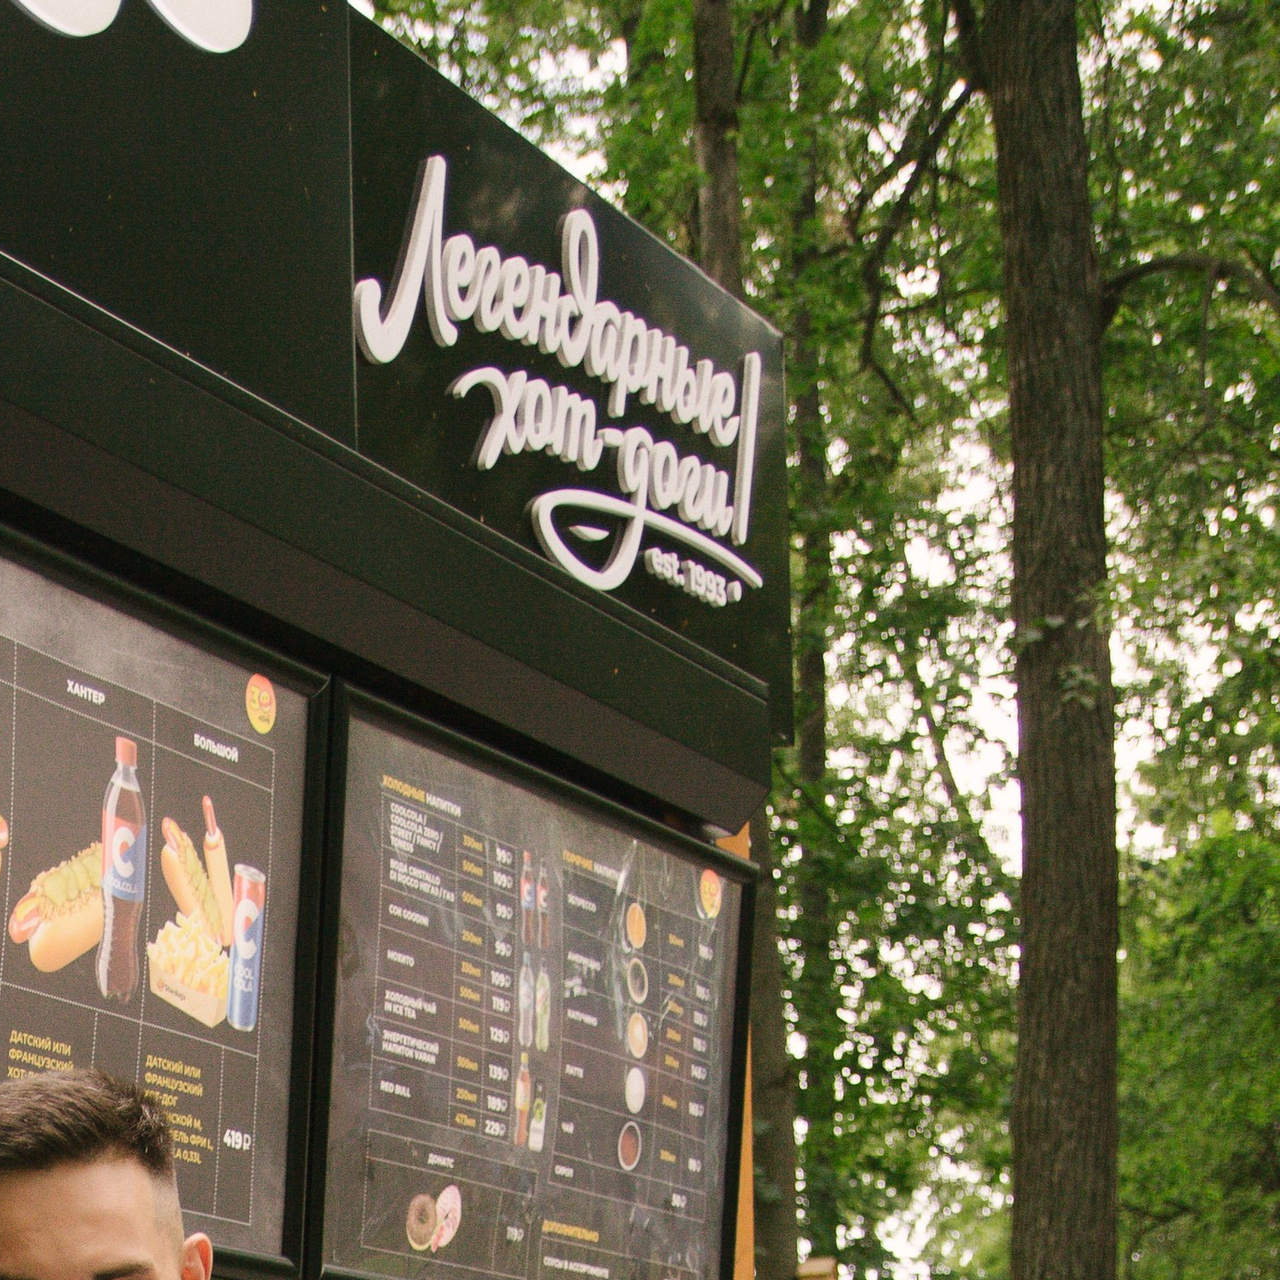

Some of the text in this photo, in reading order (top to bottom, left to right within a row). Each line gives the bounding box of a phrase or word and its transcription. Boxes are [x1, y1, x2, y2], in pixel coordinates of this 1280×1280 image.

[354, 155, 740, 447] Легендарные
[66, 678, 106, 706] ХАНТЕР
[193, 732, 239, 763] БОЛЬШОЙ
[381, 774, 462, 818] ХОЛОДНЫЕ НАПИТКИ
[9, 1030, 72, 1057] ДАТСКИЙ ИЛИ
[8, 1047, 74, 1072] ФРАНЦУЗСКИЙ
[145, 1054, 201, 1080] ДАТСКИЙ ИЛИ
[144, 1071, 204, 1098] ФРАНЦУЗСКИЙ
[189, 1133, 207, 1149] ФРИ
